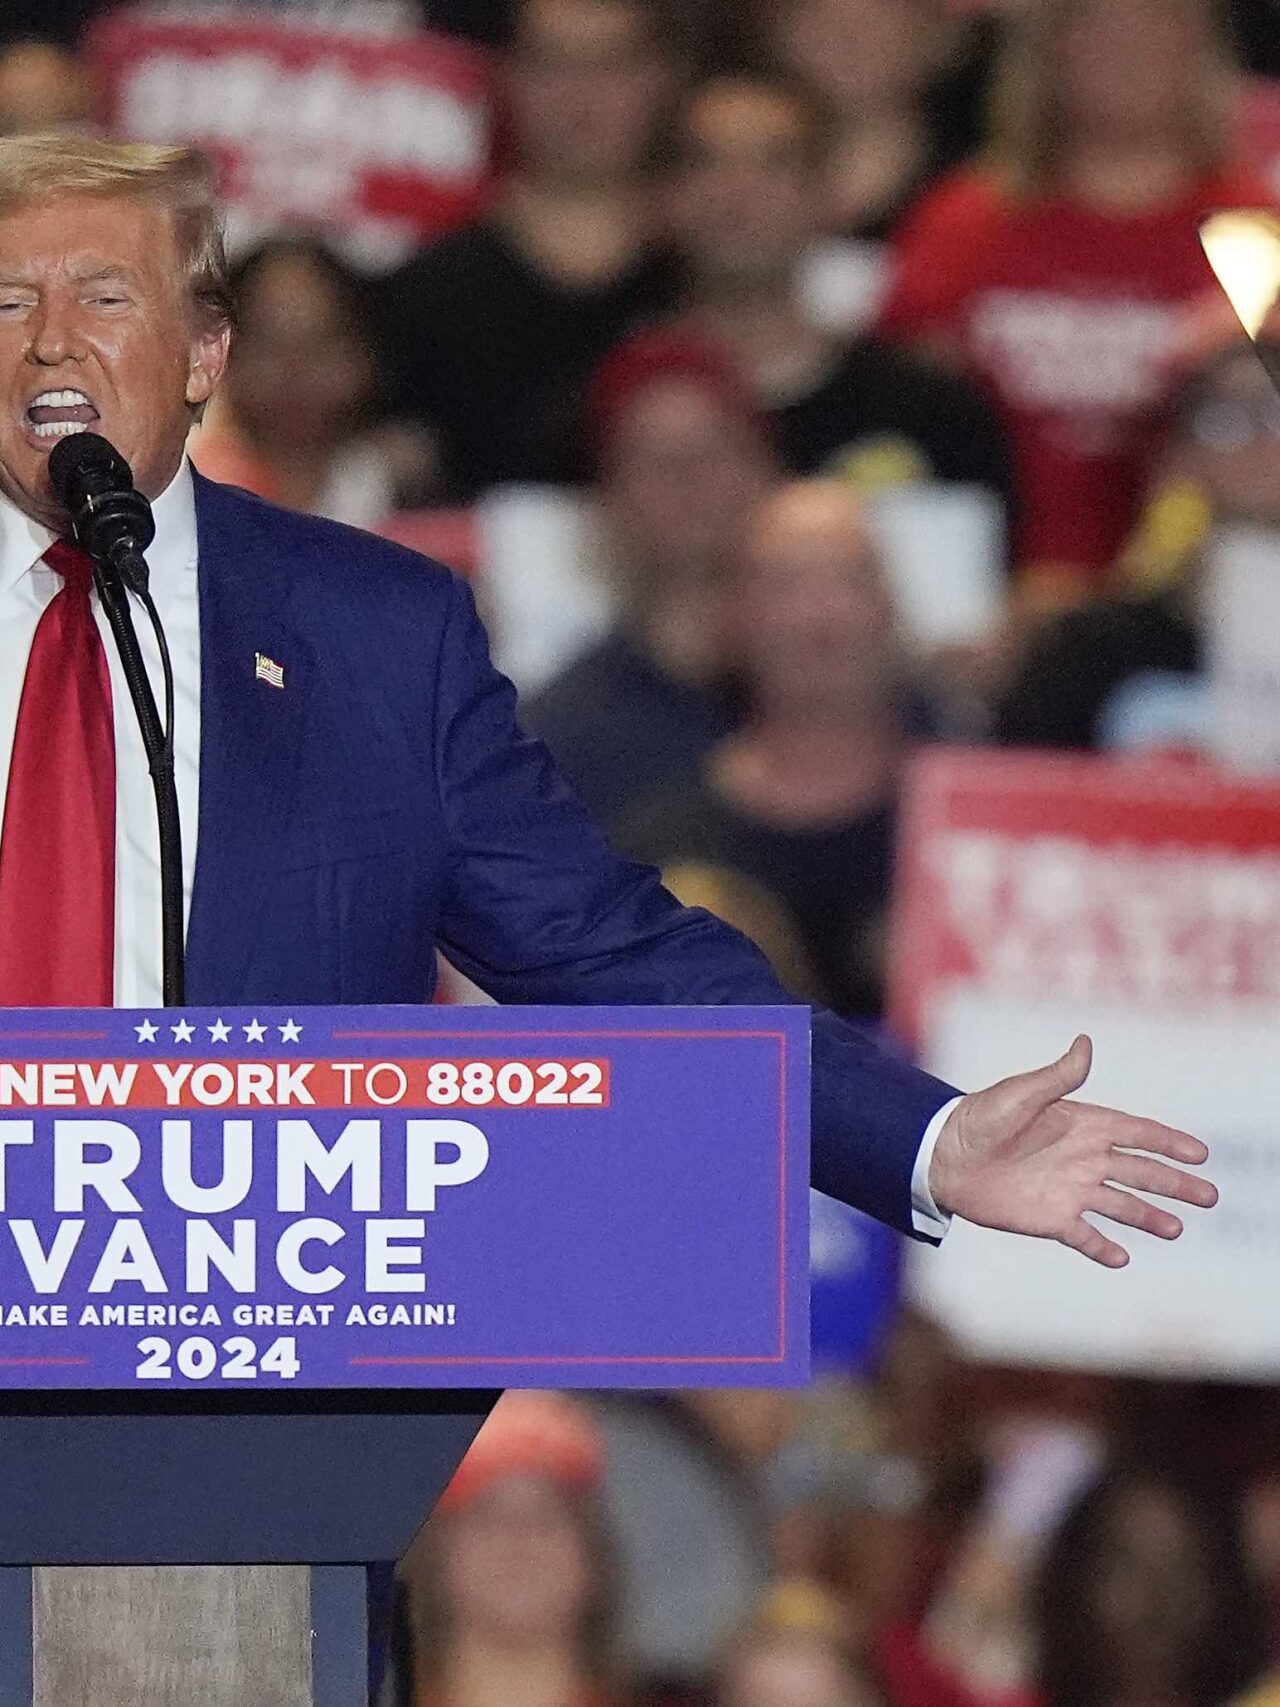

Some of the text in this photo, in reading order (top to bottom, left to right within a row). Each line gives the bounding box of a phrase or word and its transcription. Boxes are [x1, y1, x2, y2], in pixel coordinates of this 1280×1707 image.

[0, 1064, 138, 1105] NEW
[152, 1063, 315, 1105] YORK
[331, 1062, 407, 1105] TO
[426, 1062, 603, 1105] 88022
[7, 1218, 426, 1294] VANCE
[78, 1304, 221, 1326] AMERICA
[232, 1304, 334, 1326] GREAT
[345, 1304, 456, 1326] AGAIN!
[136, 1337, 300, 1379] 2024
